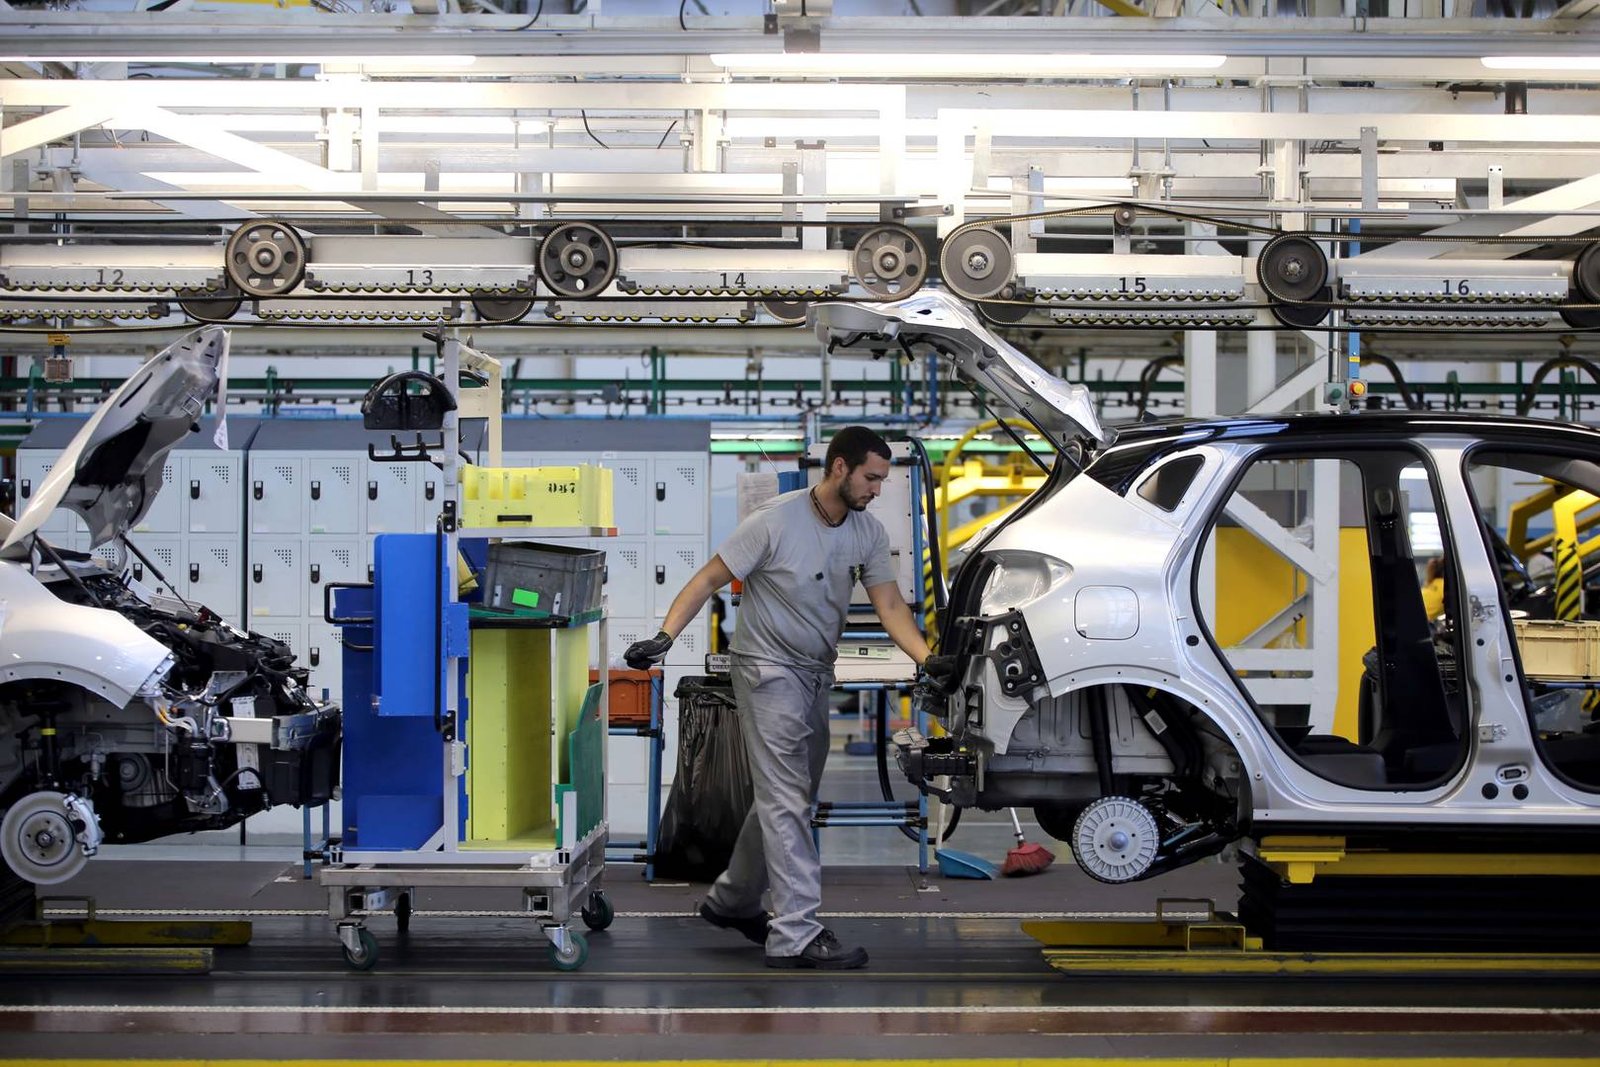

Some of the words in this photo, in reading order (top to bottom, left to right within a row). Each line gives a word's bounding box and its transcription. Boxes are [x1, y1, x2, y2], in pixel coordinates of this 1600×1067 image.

[96, 269, 123, 286] 12
[406, 269, 433, 286] 13
[719, 272, 746, 289] 14
[1118, 277, 1146, 294] 15
[1442, 280, 1470, 296] 16
